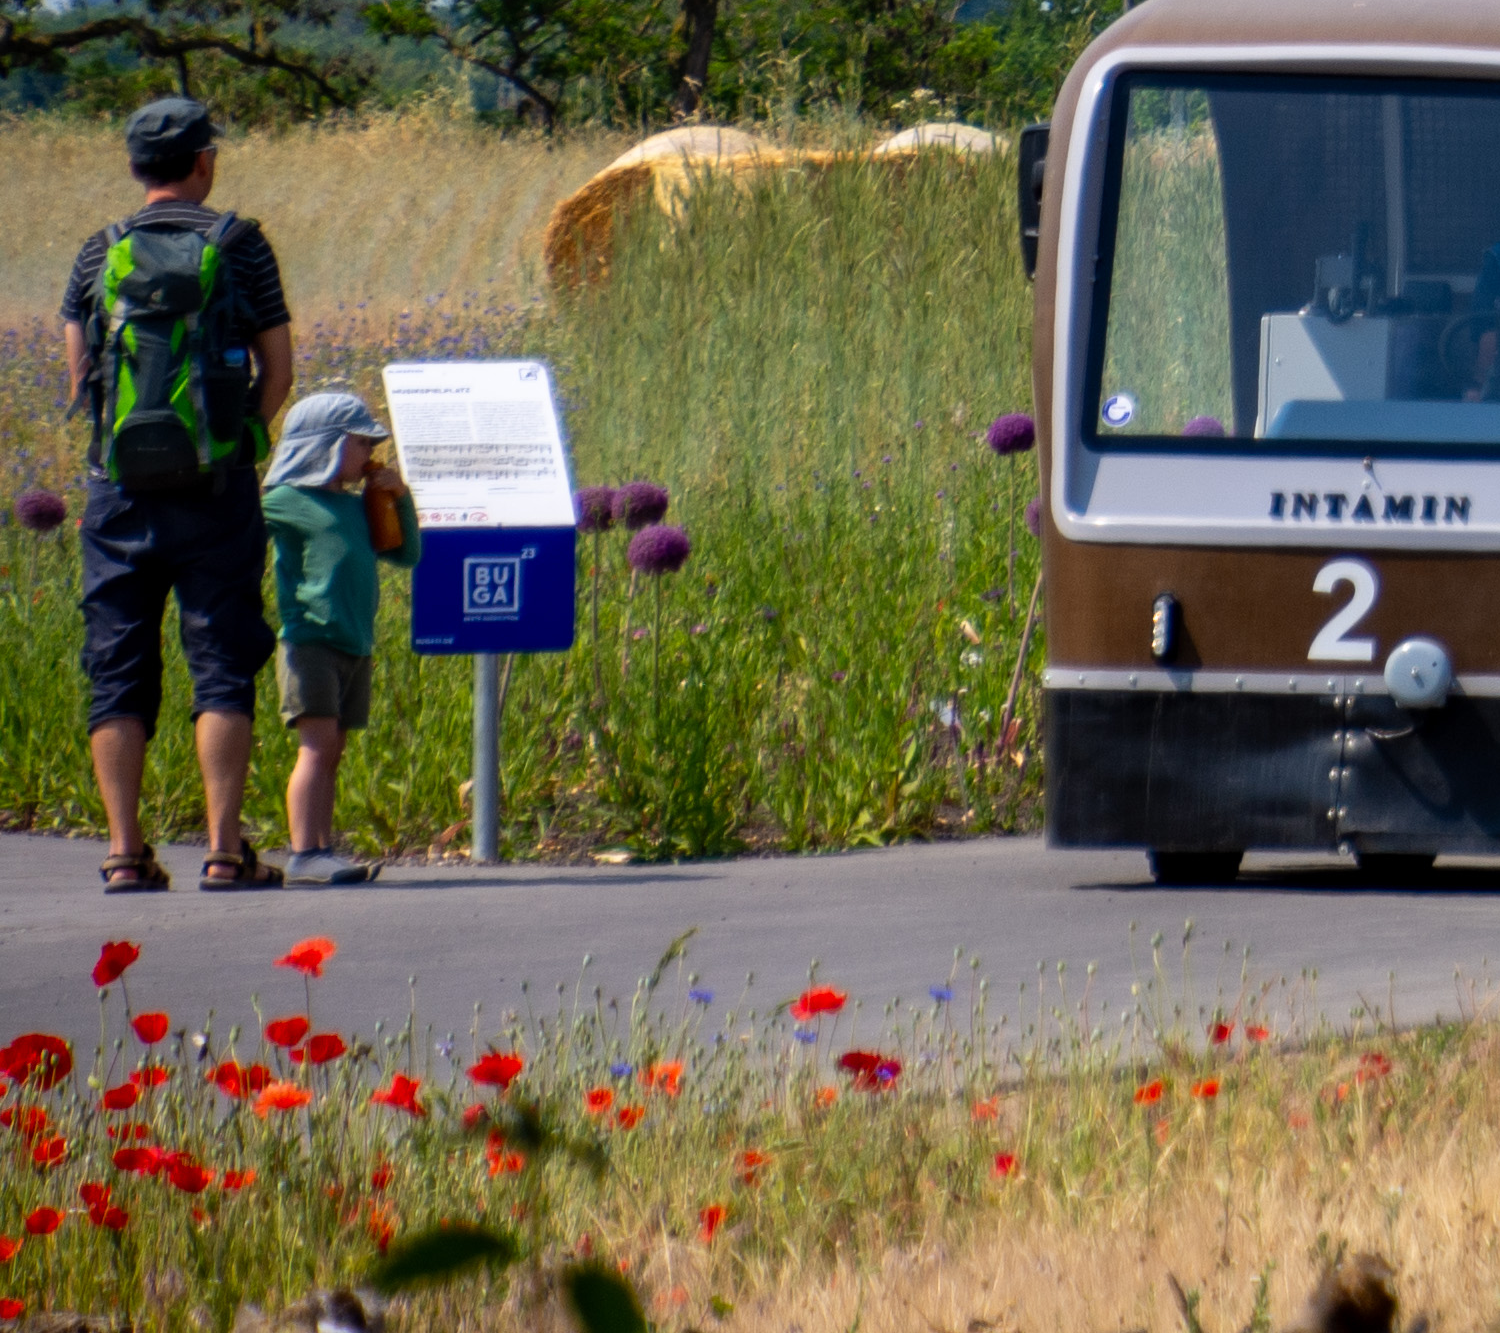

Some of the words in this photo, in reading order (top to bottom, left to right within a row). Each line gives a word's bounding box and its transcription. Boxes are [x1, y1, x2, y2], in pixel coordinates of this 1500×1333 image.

[1268, 491, 1472, 525] INTAMIN
[521, 547, 537, 560] 23
[475, 566, 510, 586] BU
[472, 586, 508, 605] GA
[1307, 559, 1377, 662] 2
